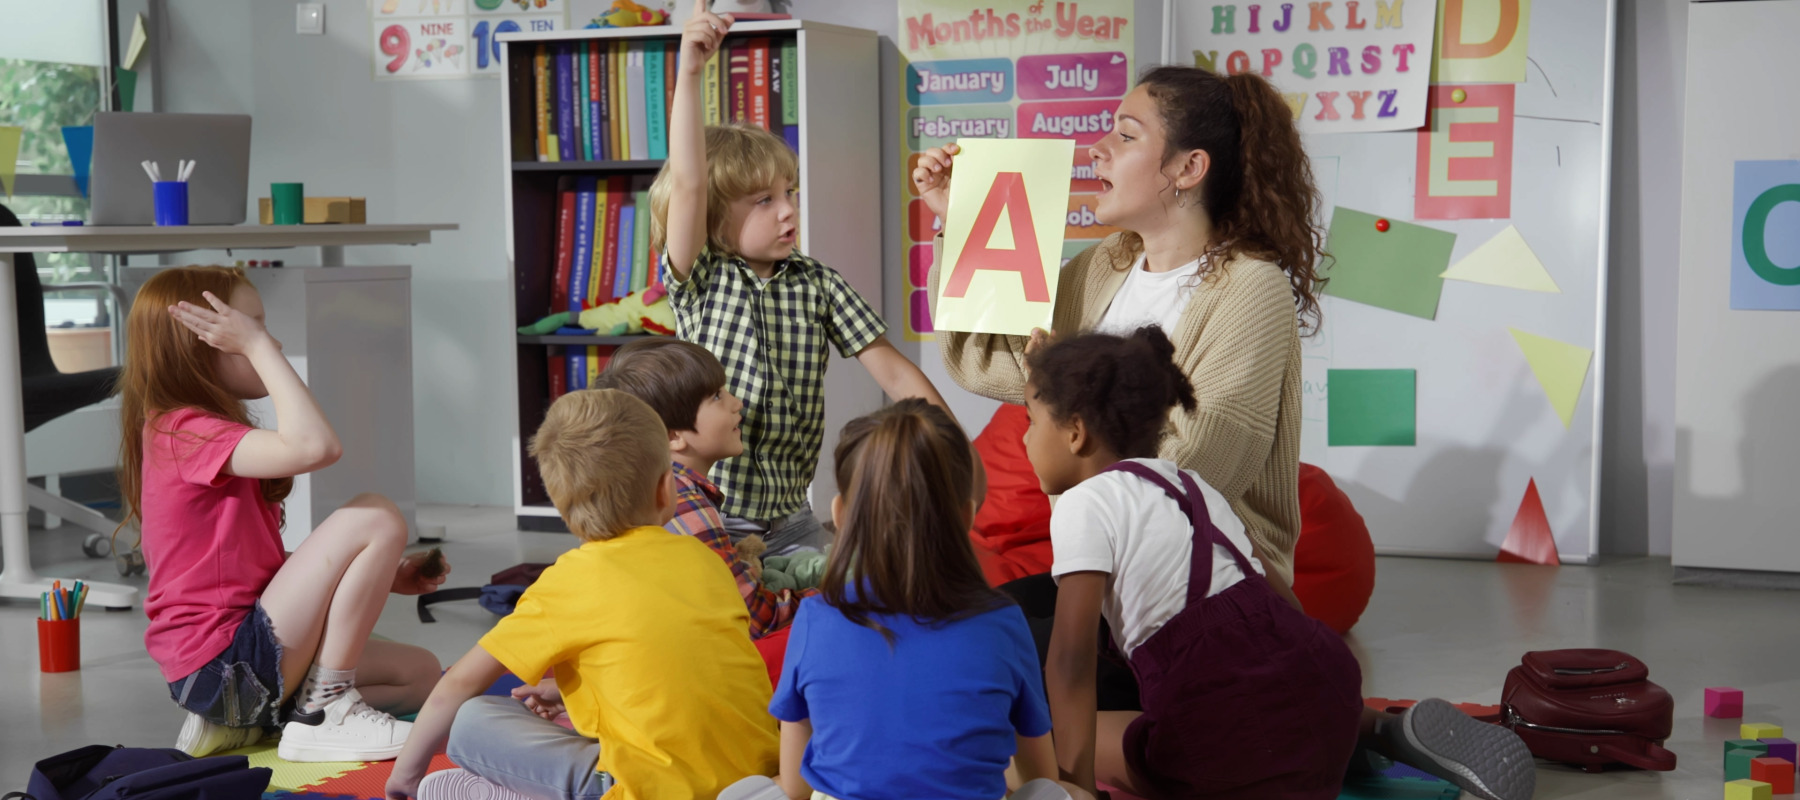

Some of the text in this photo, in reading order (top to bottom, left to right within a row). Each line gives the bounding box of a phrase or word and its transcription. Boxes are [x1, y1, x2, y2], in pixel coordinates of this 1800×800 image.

[380, 24, 411, 73] 9
[420, 23, 454, 36] NINE
[529, 20, 554, 32] TEN
[905, 0, 1128, 51] Months of the Year
[1440, 0, 1520, 59] D
[707, 82, 716, 105] Bang
[708, 64, 716, 80] Big
[754, 48, 764, 126] WORLD HISTO
[772, 58, 781, 94] LAW
[915, 70, 1005, 94] January
[1044, 63, 1099, 92] July
[537, 65, 546, 132] Chemistry
[650, 87, 660, 142] SURGERY
[1031, 109, 1113, 136] August
[591, 102, 600, 155] POLITICS
[912, 117, 1009, 139] February
[1428, 106, 1499, 197] E
[572, 192, 589, 304] Theory of Relativity
[595, 202, 605, 249] Thermo
[603, 202, 617, 287] Vector Analysis
[942, 171, 1051, 303] A
